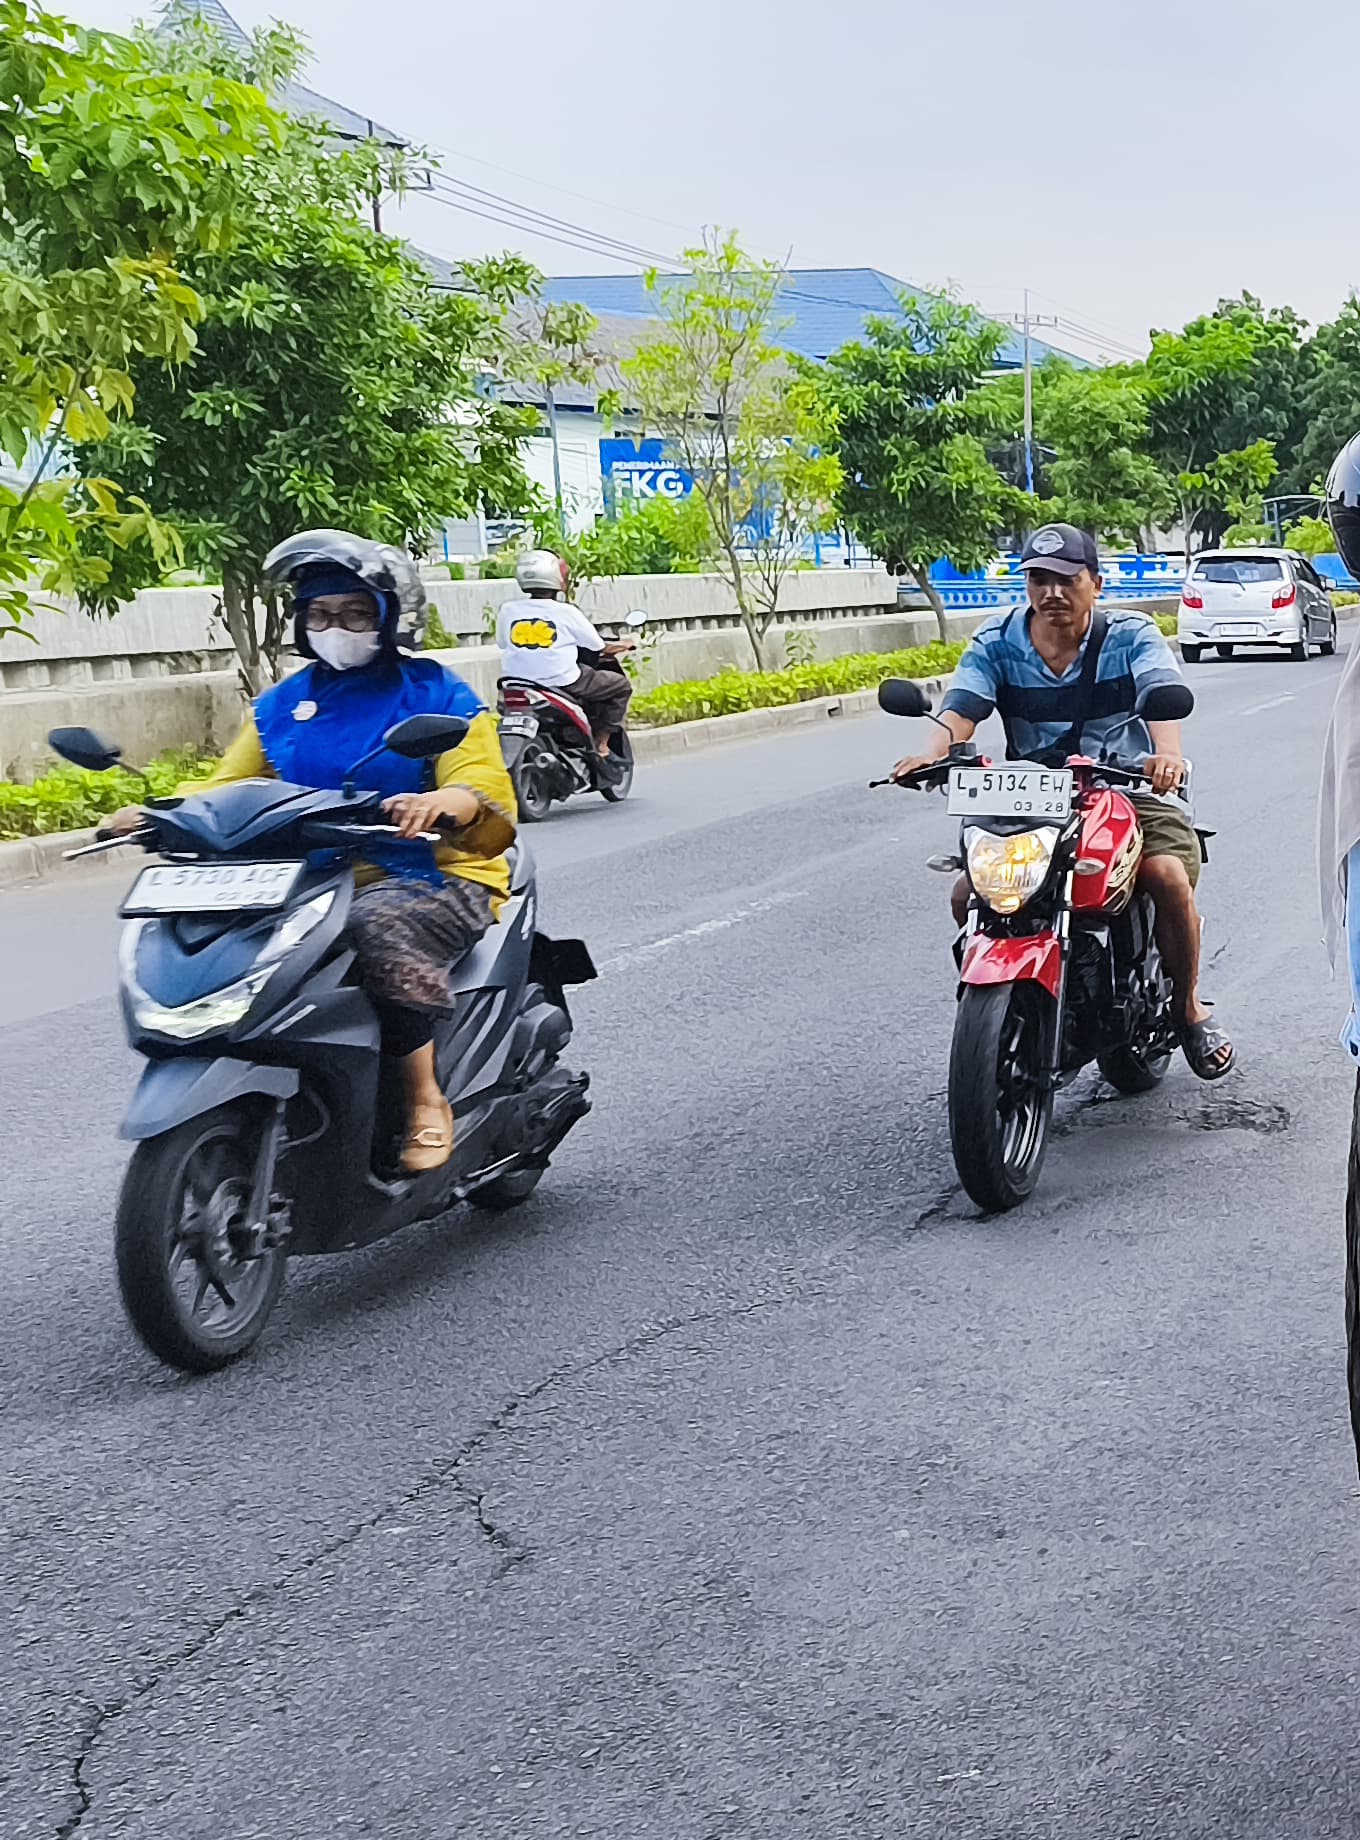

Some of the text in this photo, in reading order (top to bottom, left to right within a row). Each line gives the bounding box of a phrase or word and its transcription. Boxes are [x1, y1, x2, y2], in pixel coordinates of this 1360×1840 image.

[613, 471, 684, 498] FKG
[957, 772, 1065, 793] L 5134 EW
